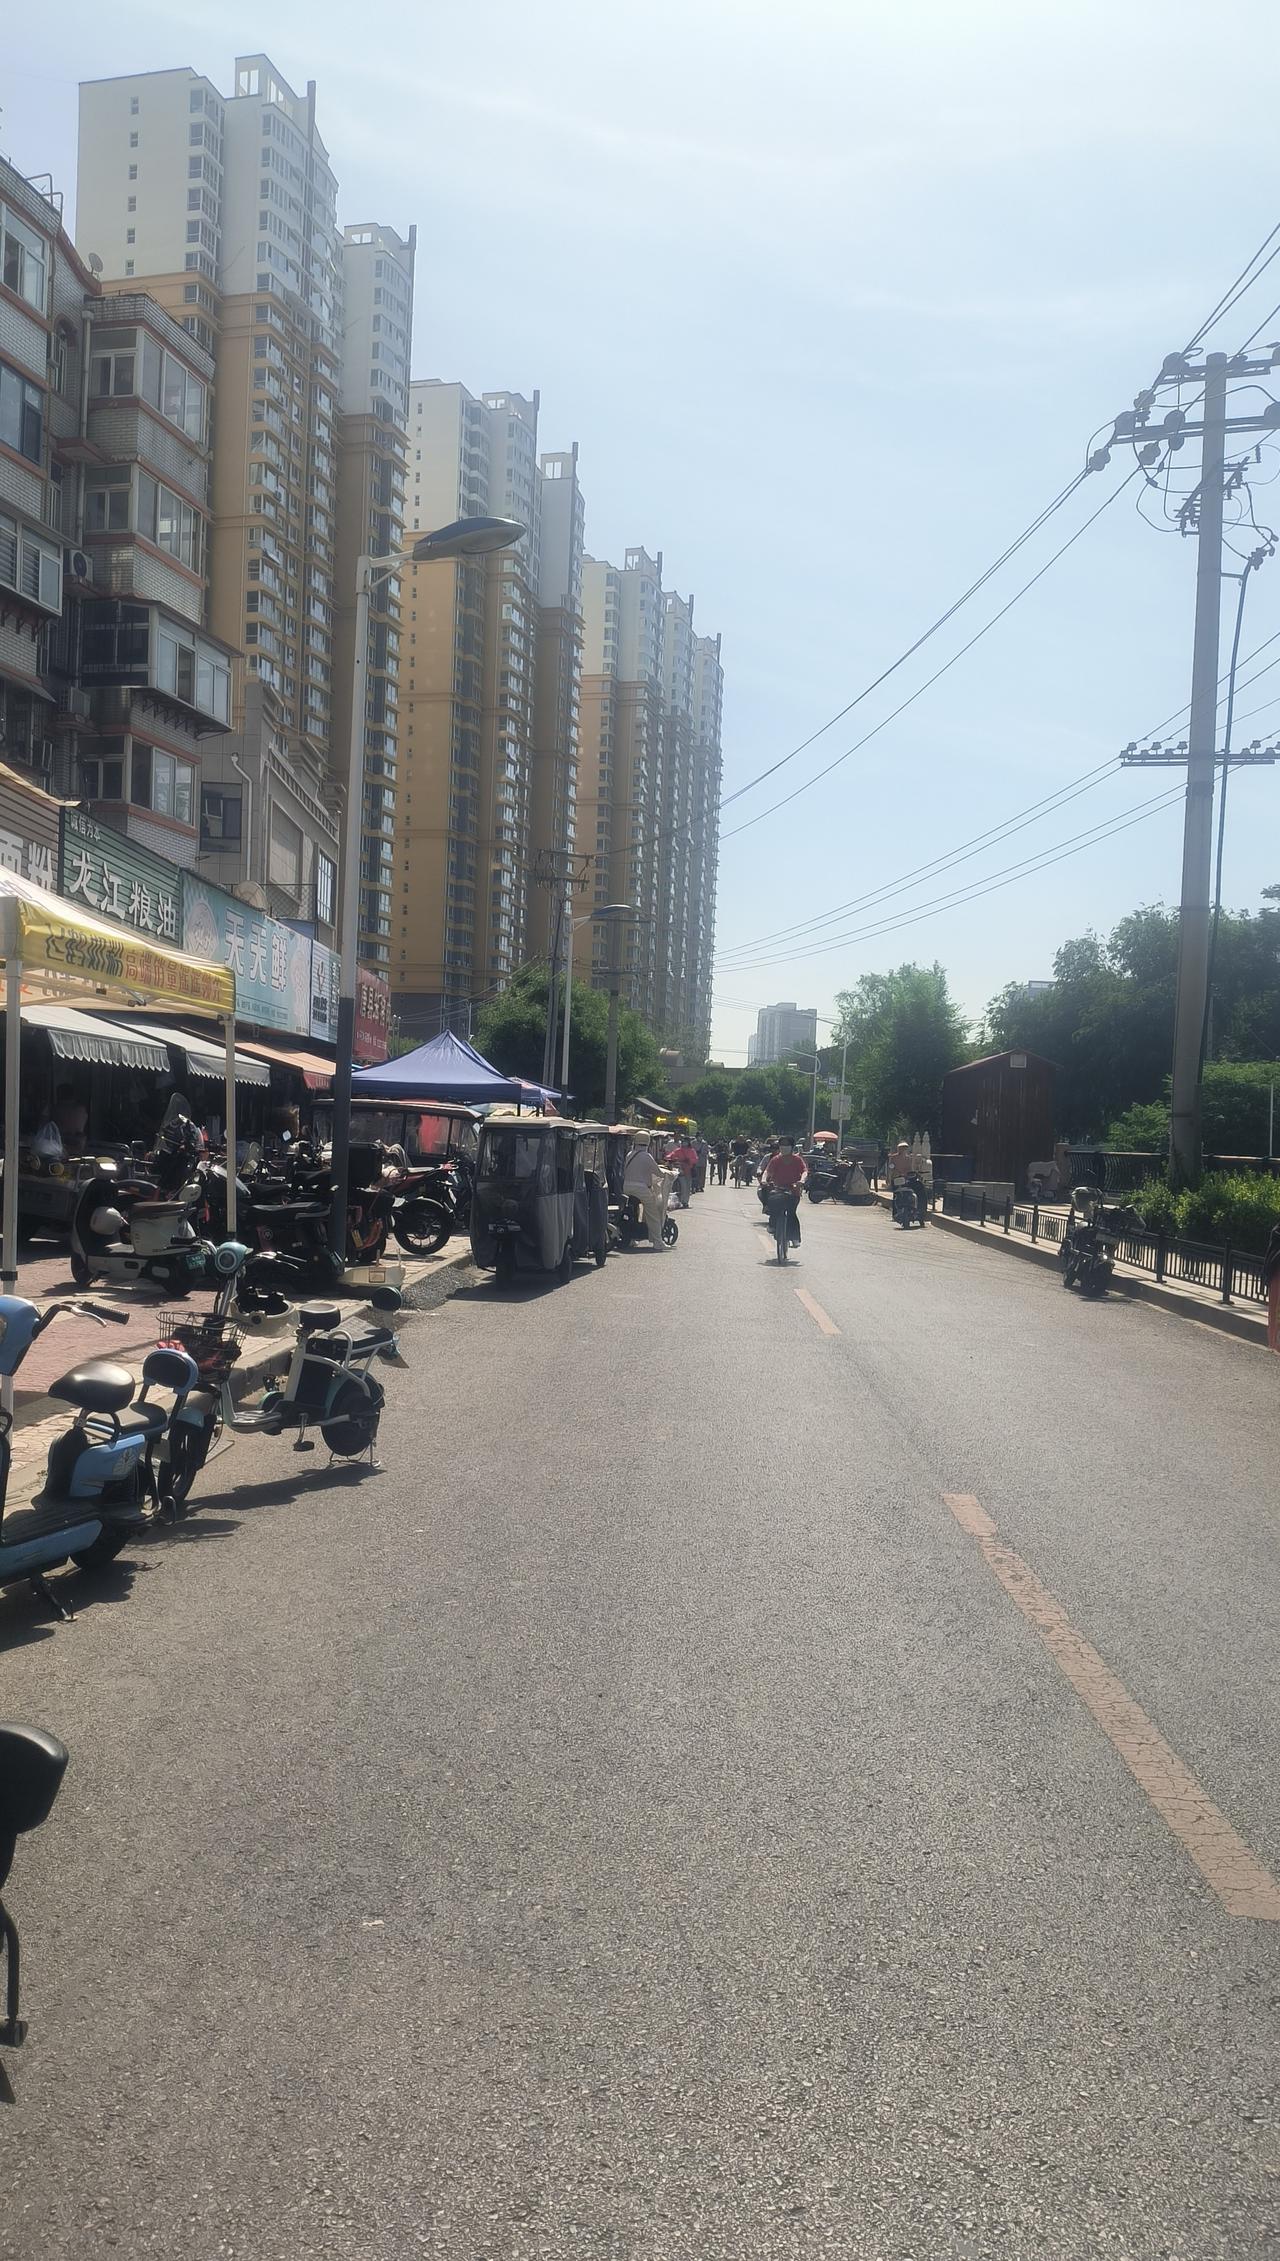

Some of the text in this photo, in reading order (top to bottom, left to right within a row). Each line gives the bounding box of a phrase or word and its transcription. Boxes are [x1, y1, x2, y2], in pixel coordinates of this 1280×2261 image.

[70, 811, 101, 842] 诚信为本
[69, 850, 177, 940] 龙江粮油
[225, 907, 288, 993] 天天鲜
